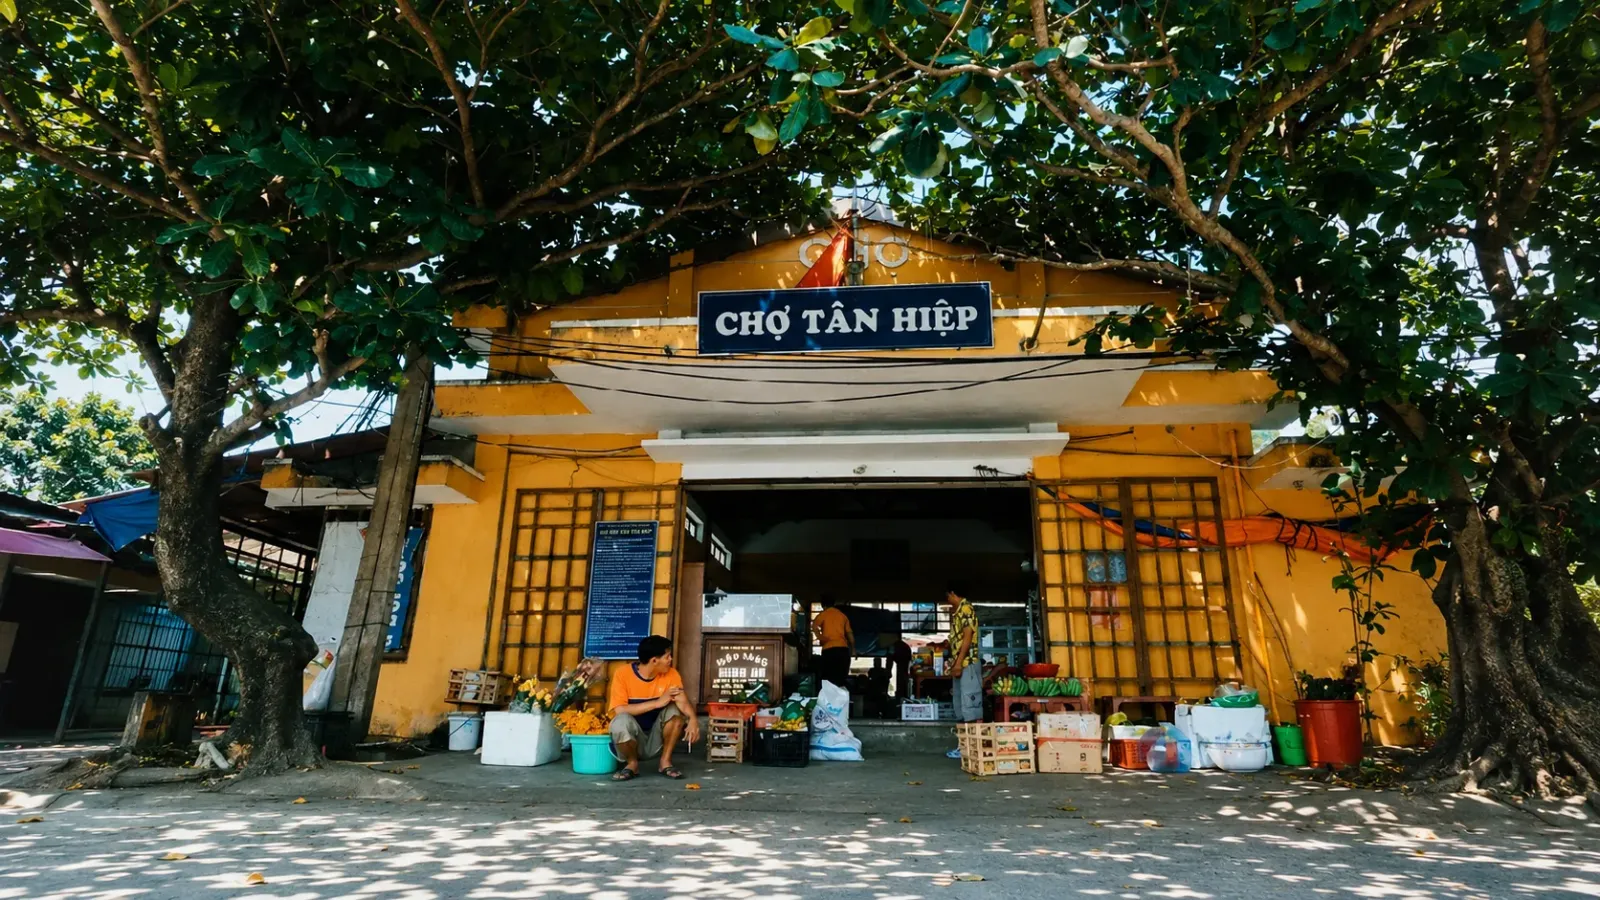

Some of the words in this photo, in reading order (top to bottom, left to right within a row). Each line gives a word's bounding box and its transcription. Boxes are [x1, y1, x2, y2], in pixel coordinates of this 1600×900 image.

[715, 305, 791, 341] CHỢ
[802, 301, 880, 334] TÂN
[892, 298, 978, 337] HIỆP
